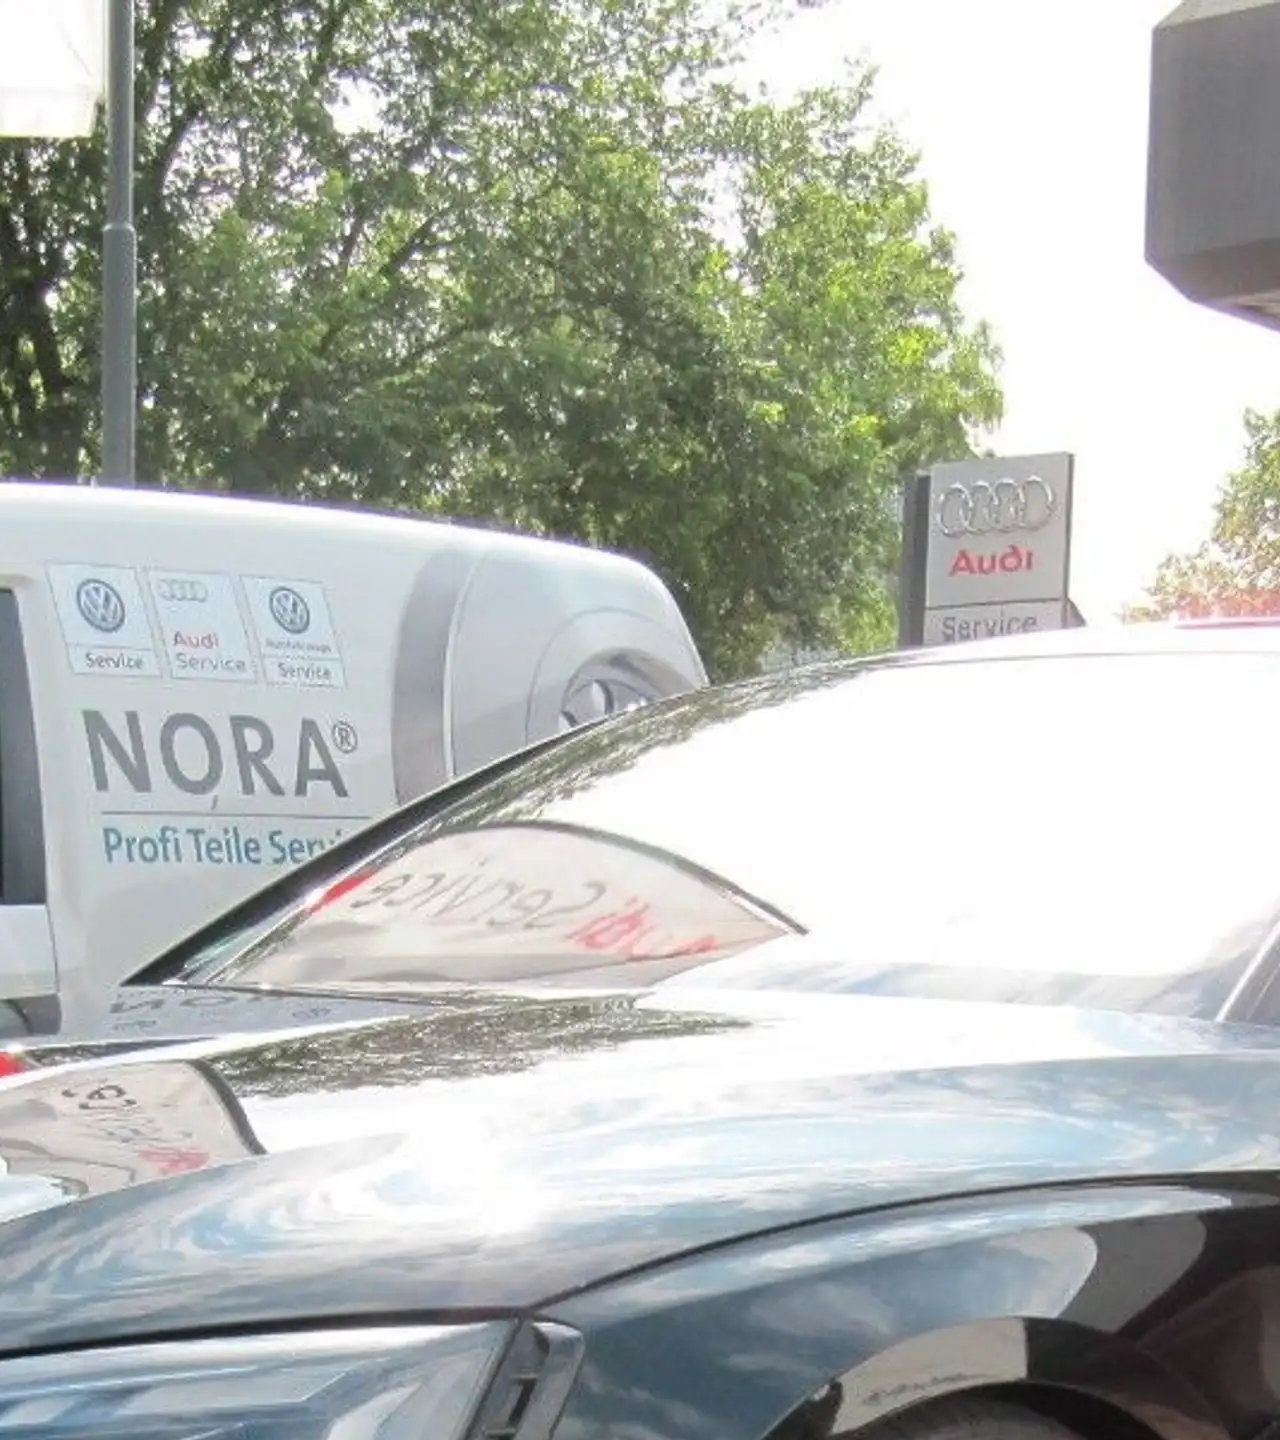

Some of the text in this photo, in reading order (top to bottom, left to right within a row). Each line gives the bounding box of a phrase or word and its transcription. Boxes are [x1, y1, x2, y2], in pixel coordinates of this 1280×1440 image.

[949, 545, 1033, 577] Audi
[942, 613, 1038, 642] Service
[173, 631, 219, 650] Audi
[84, 652, 145, 671] Service
[175, 652, 247, 673] Service
[276, 661, 332, 681] Service
[102, 825, 182, 864] Profi
[186, 826, 262, 864] Teile
